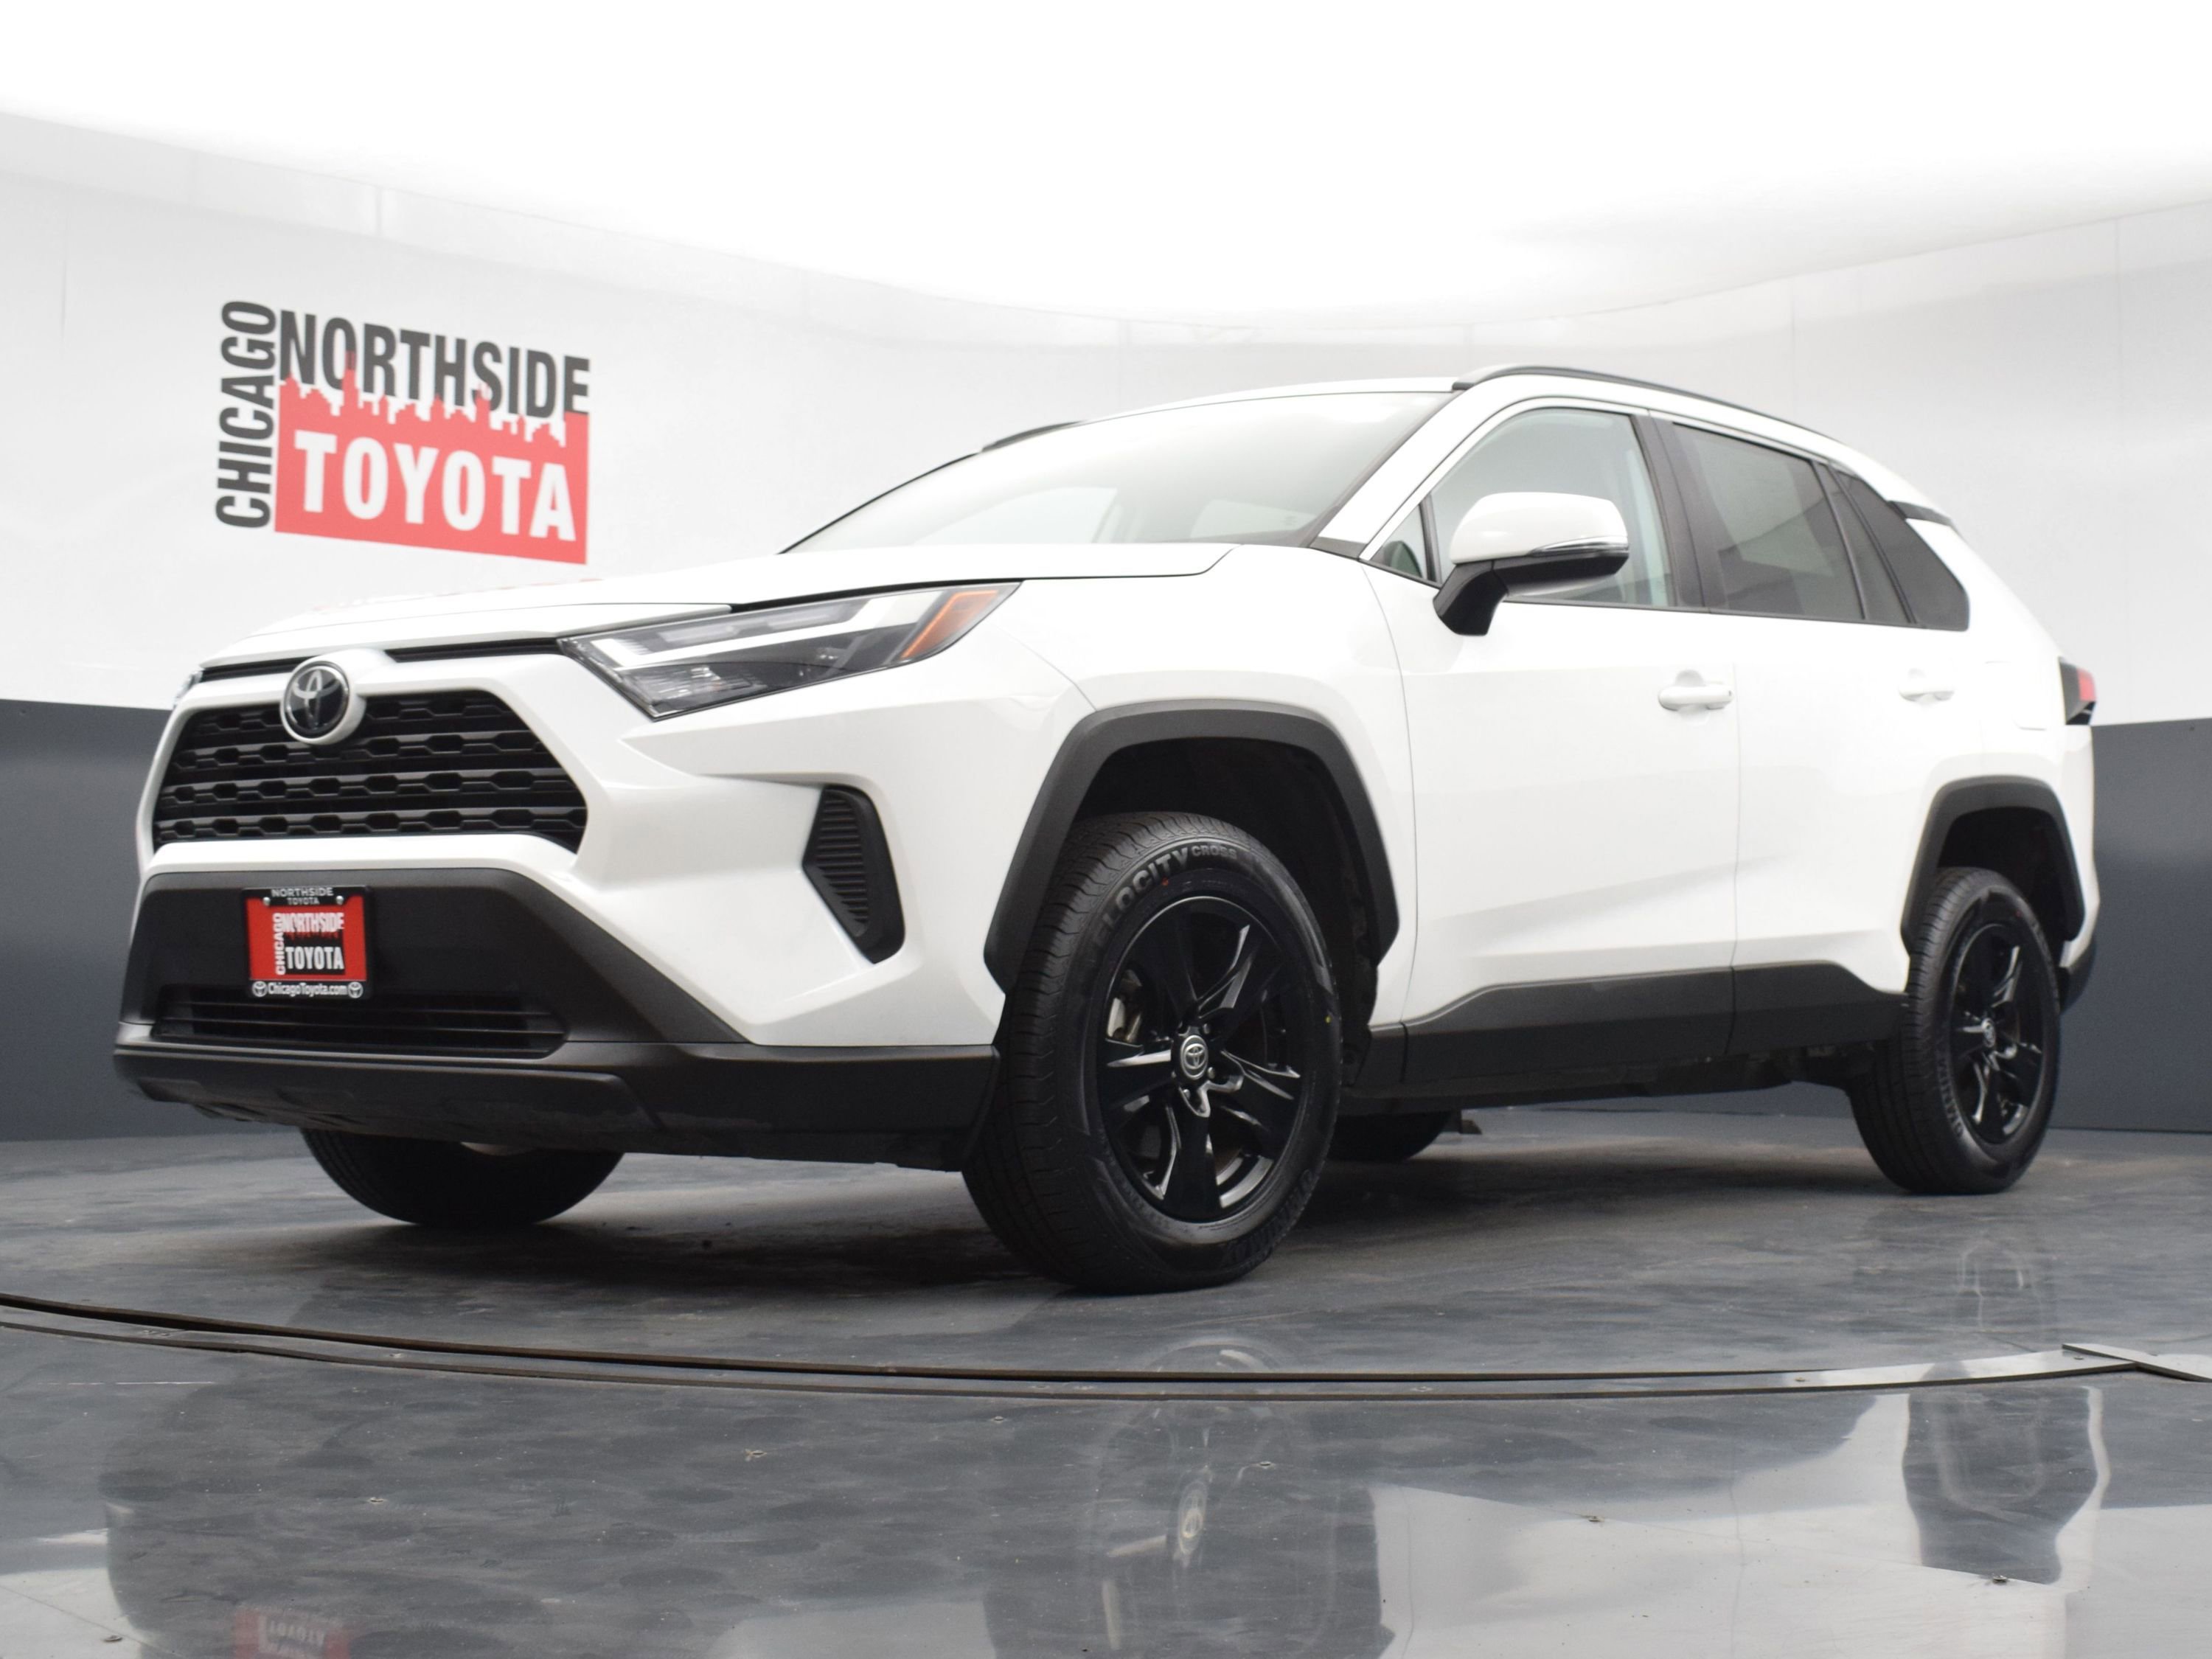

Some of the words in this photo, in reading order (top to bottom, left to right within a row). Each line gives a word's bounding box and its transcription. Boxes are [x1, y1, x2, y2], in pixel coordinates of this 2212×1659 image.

[279, 309, 590, 420] NORTHSIDE
[215, 300, 277, 529] CHICAGO
[294, 429, 577, 542] TOYOTA
[1191, 845, 1238, 860] CROSS
[271, 888, 334, 897] NORTHSIDE
[287, 897, 320, 905] TOYOTA
[284, 913, 344, 933] NORTHSIDE
[272, 913, 285, 975] CHICAGO
[285, 947, 344, 970] TOYOTA
[268, 982, 348, 997] ChicagoToyota.com
